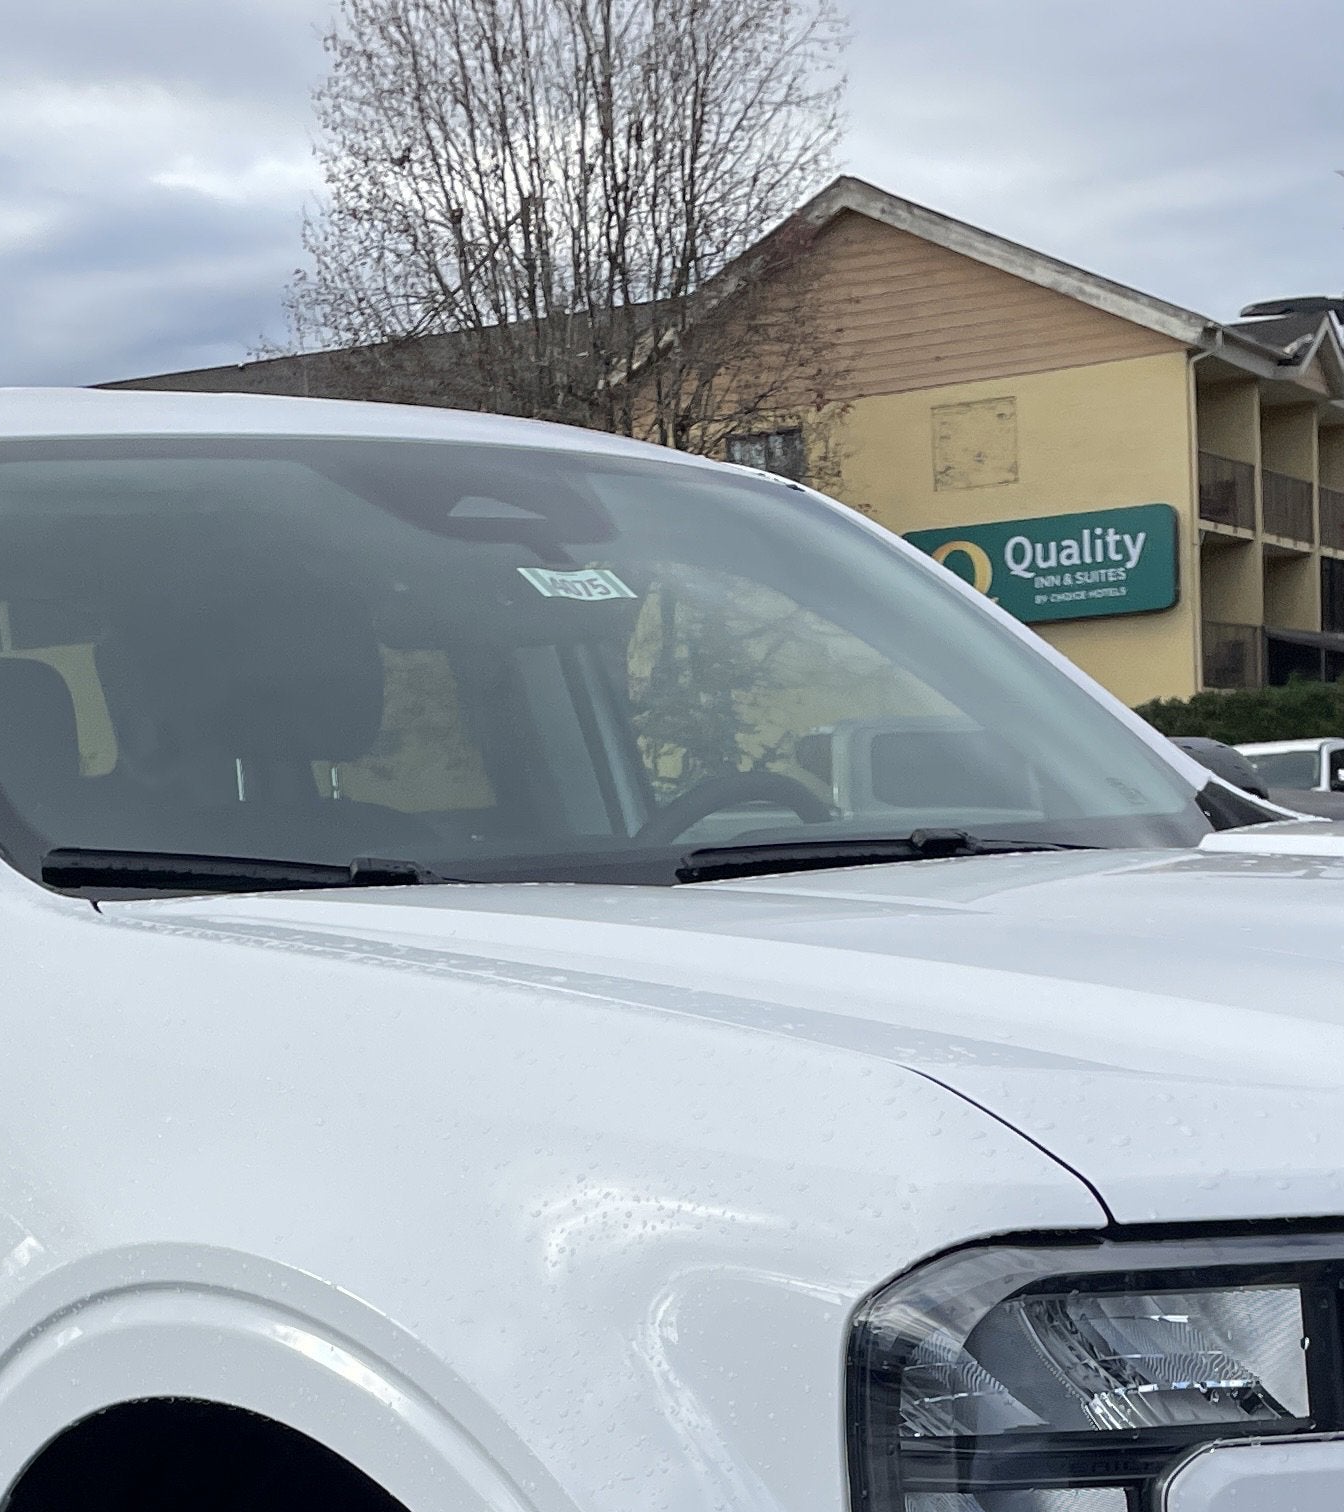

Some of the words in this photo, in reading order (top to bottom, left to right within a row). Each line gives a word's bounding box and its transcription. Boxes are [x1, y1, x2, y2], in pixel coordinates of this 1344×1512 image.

[1004, 528, 1146, 578] Quality
[1034, 575, 1061, 589] INN
[1063, 573, 1073, 586] &
[1075, 567, 1127, 584] SUITES
[1050, 590, 1087, 603] CHOICE
[1088, 586, 1127, 599] HOTELS
